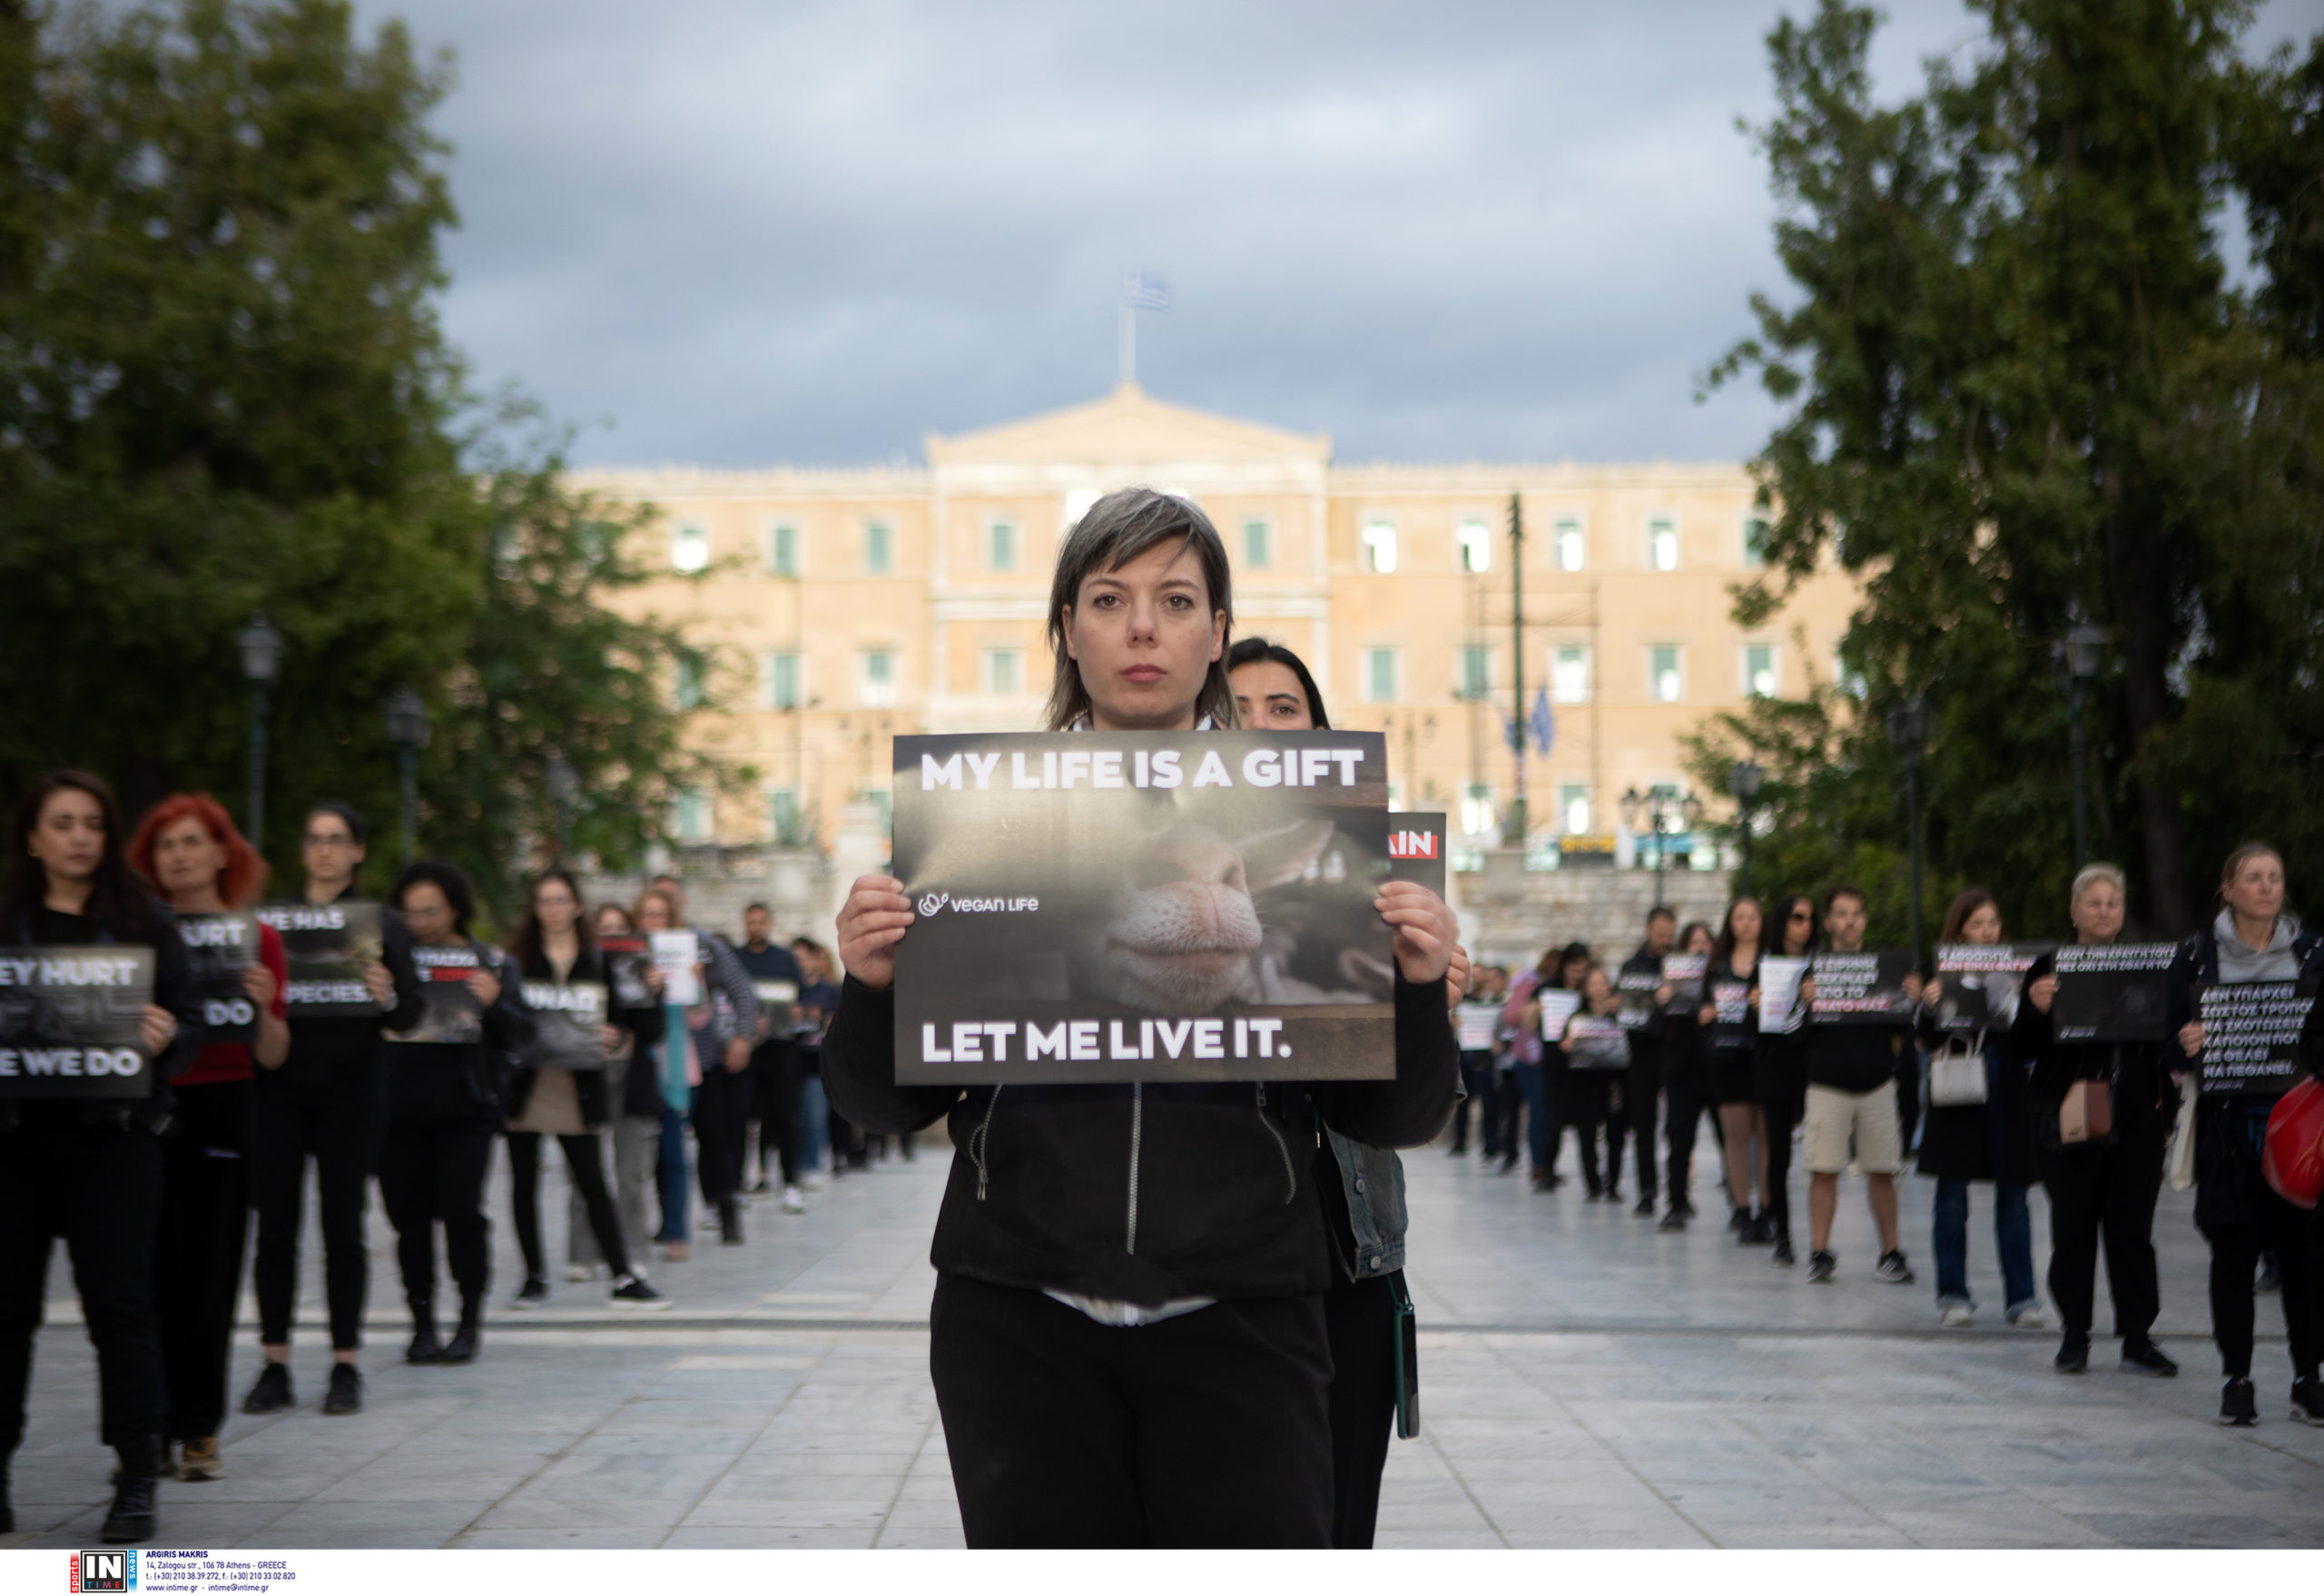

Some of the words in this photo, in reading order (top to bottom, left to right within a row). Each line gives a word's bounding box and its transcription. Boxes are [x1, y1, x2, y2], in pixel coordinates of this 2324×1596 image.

[921, 753, 1001, 791] MY
[1011, 751, 1124, 790] LIFE
[1135, 750, 1184, 788] IS
[1191, 750, 1234, 788] A
[1243, 749, 1364, 787] GIFT
[294, 906, 346, 930] HAS
[40, 958, 138, 985] HURT
[2201, 986, 2230, 1003] ΔΕΝ
[2232, 983, 2295, 1002] ΥΠΑΡΧΕΙ
[204, 997, 254, 1026] DO
[2201, 1002, 2260, 1018] ΣΩΣΤΟΣ
[922, 1021, 1017, 1063] LET
[1026, 1020, 1100, 1061] ME
[1110, 1019, 1225, 1060] LIVE
[1235, 1018, 1293, 1059] IT.
[20, 1049, 83, 1077] WE
[84, 1047, 143, 1077] DO
